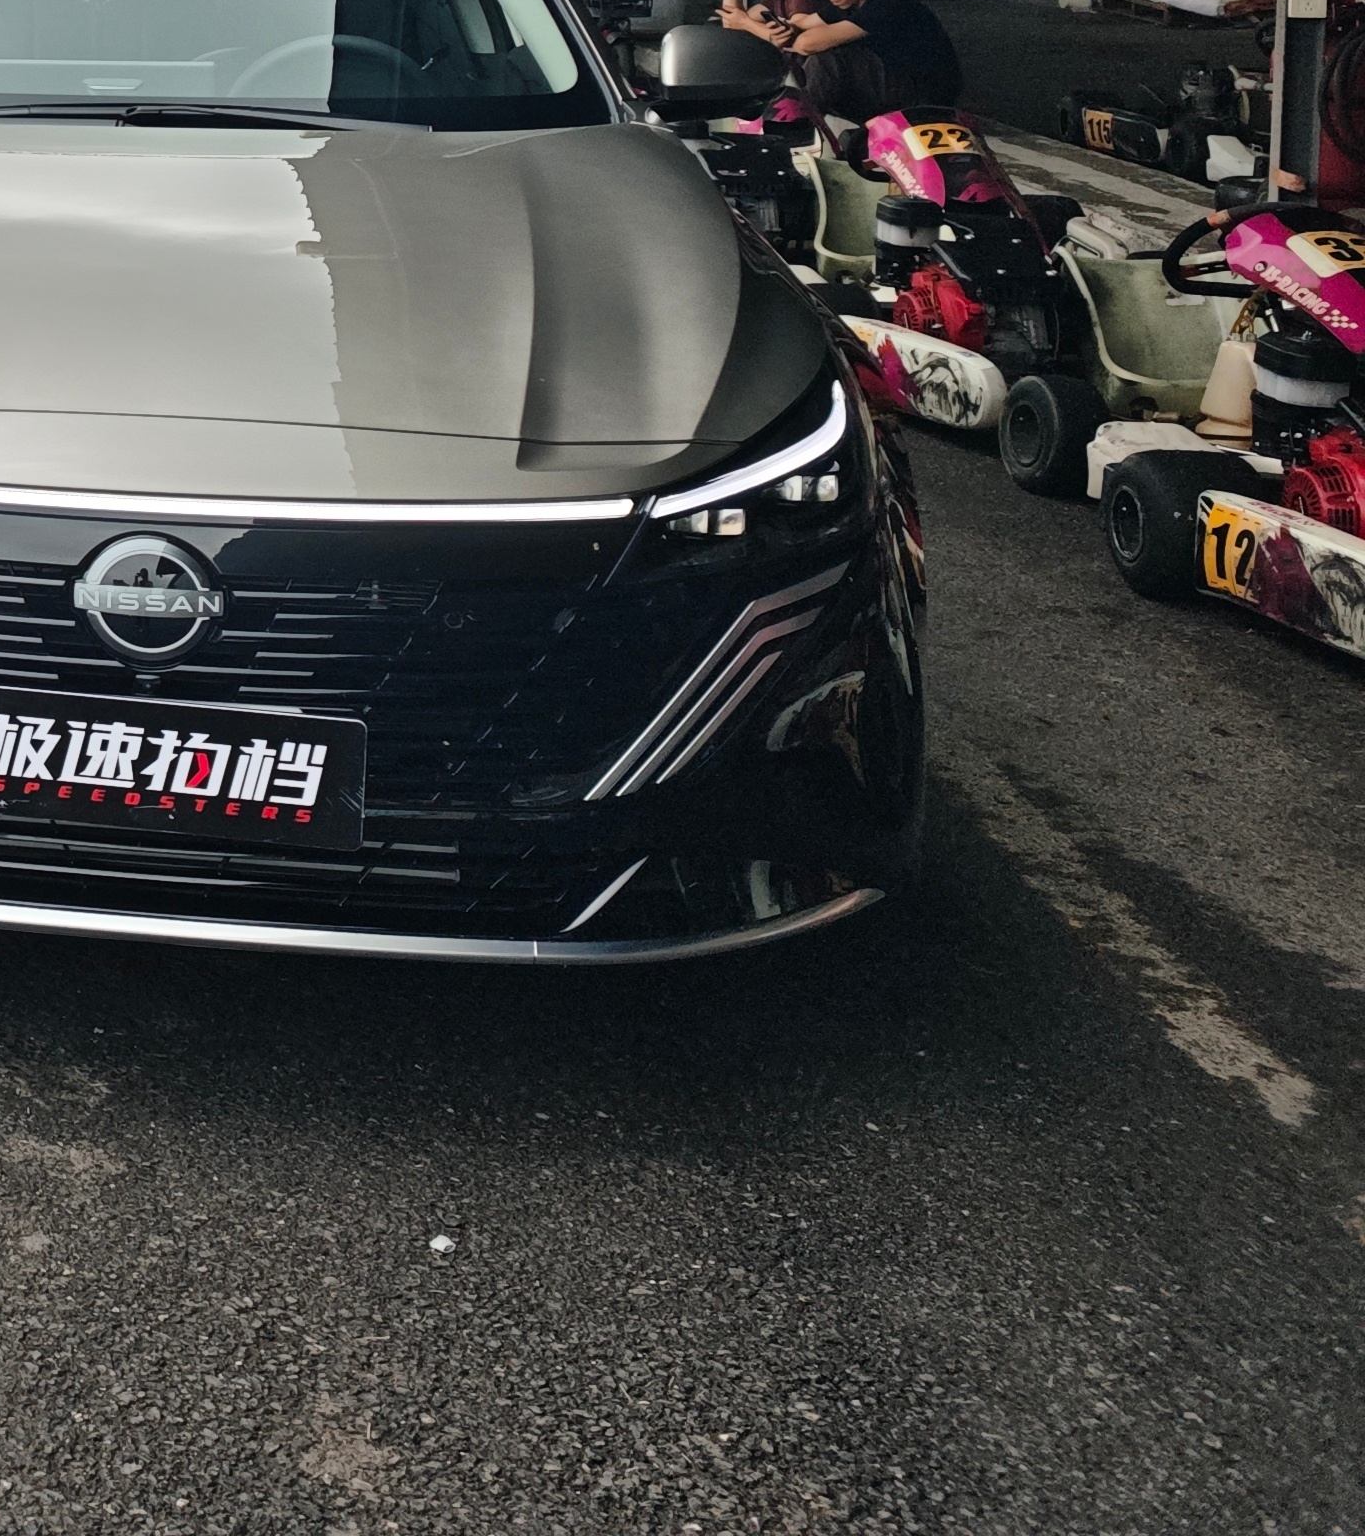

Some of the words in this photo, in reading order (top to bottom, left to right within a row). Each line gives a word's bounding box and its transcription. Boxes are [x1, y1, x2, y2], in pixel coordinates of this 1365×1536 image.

[1087, 117, 1112, 145] 115
[1313, 236, 1365, 262] 3
[1211, 522, 1256, 586] 12
[77, 588, 220, 614] NISSAN
